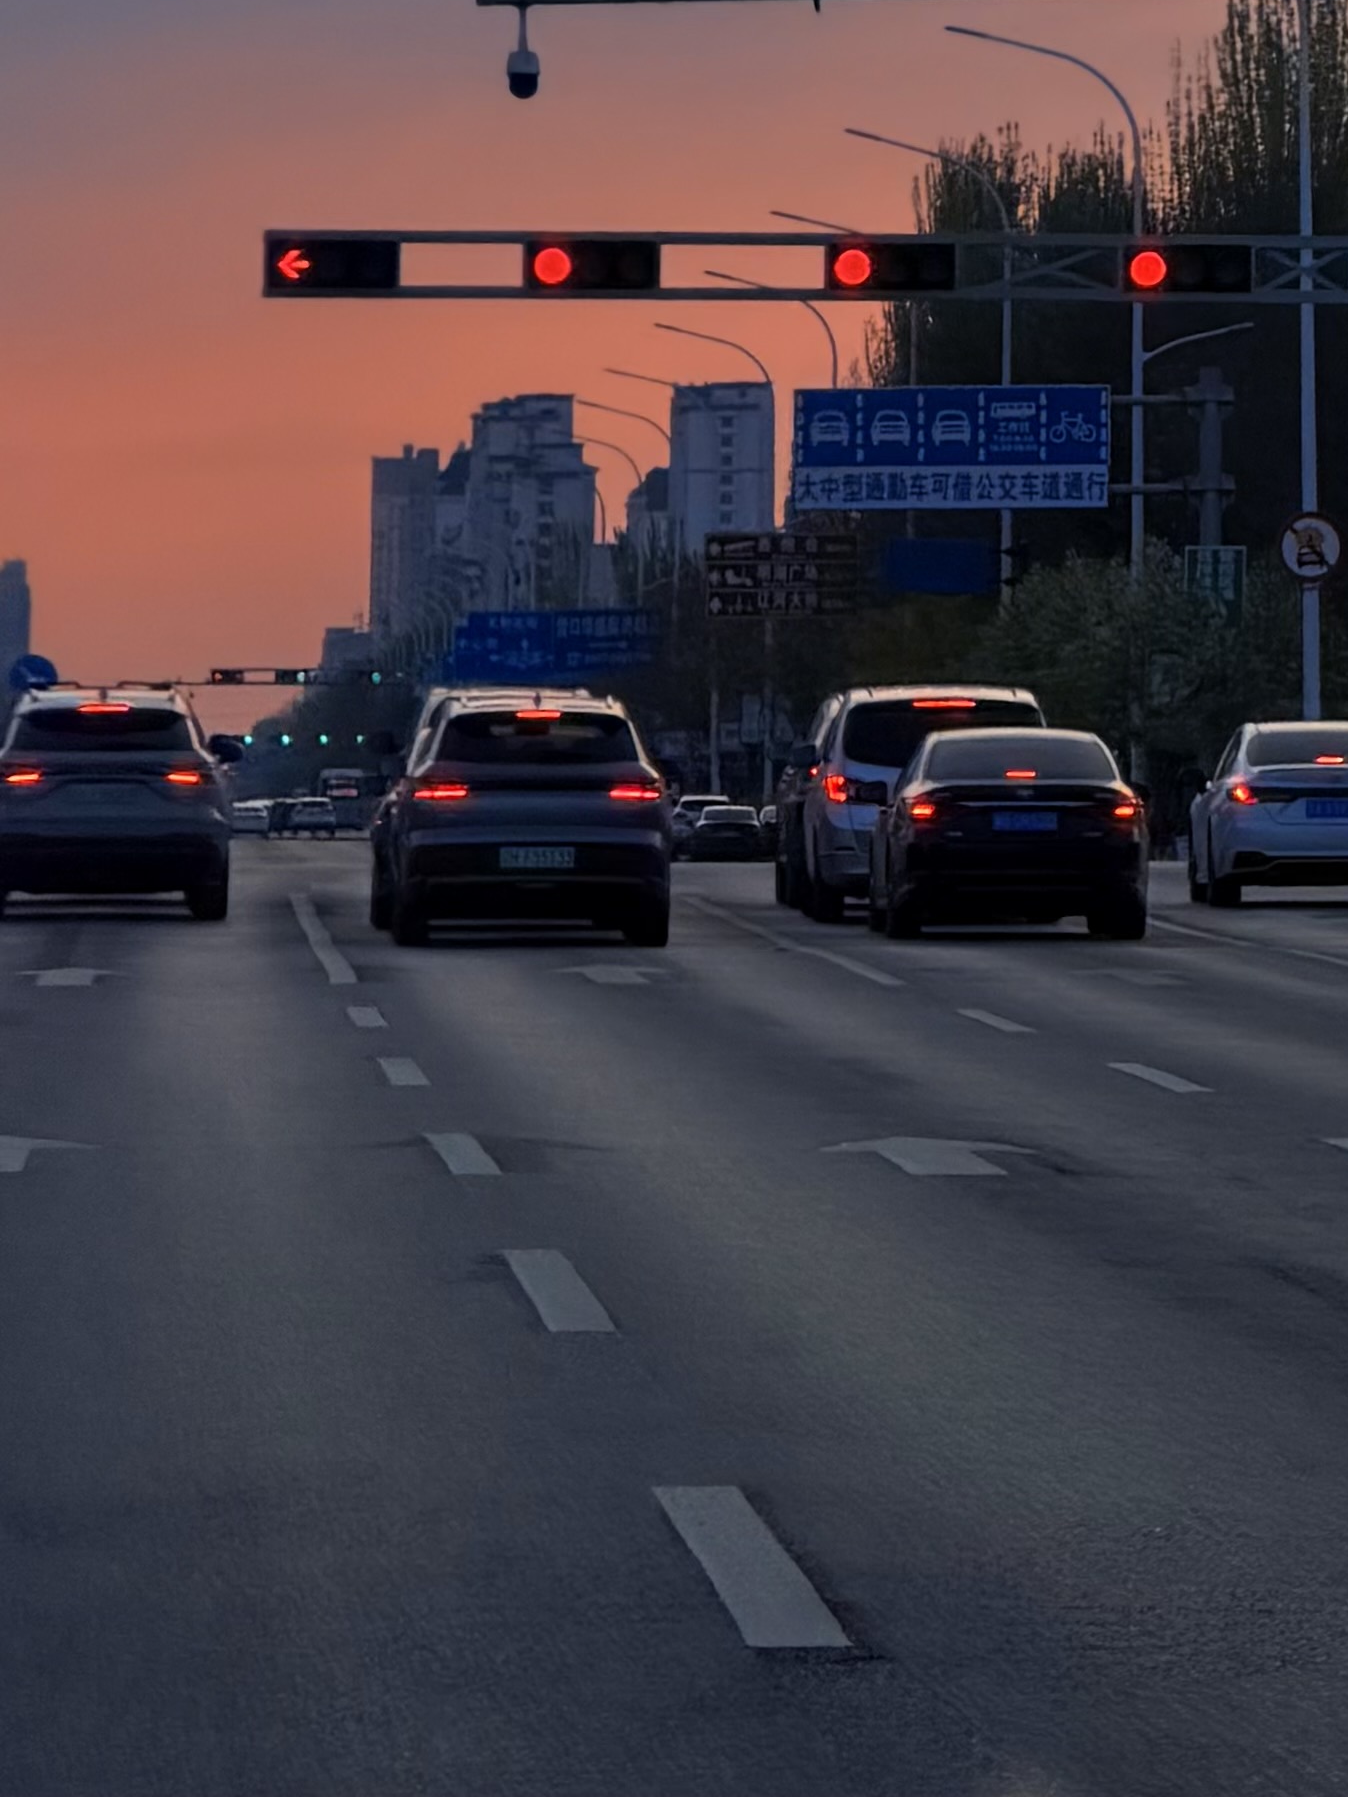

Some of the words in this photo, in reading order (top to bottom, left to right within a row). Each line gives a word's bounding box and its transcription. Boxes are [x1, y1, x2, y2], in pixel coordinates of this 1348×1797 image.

[798, 472, 1107, 503] 大中型通勤车可借公交车道通行
